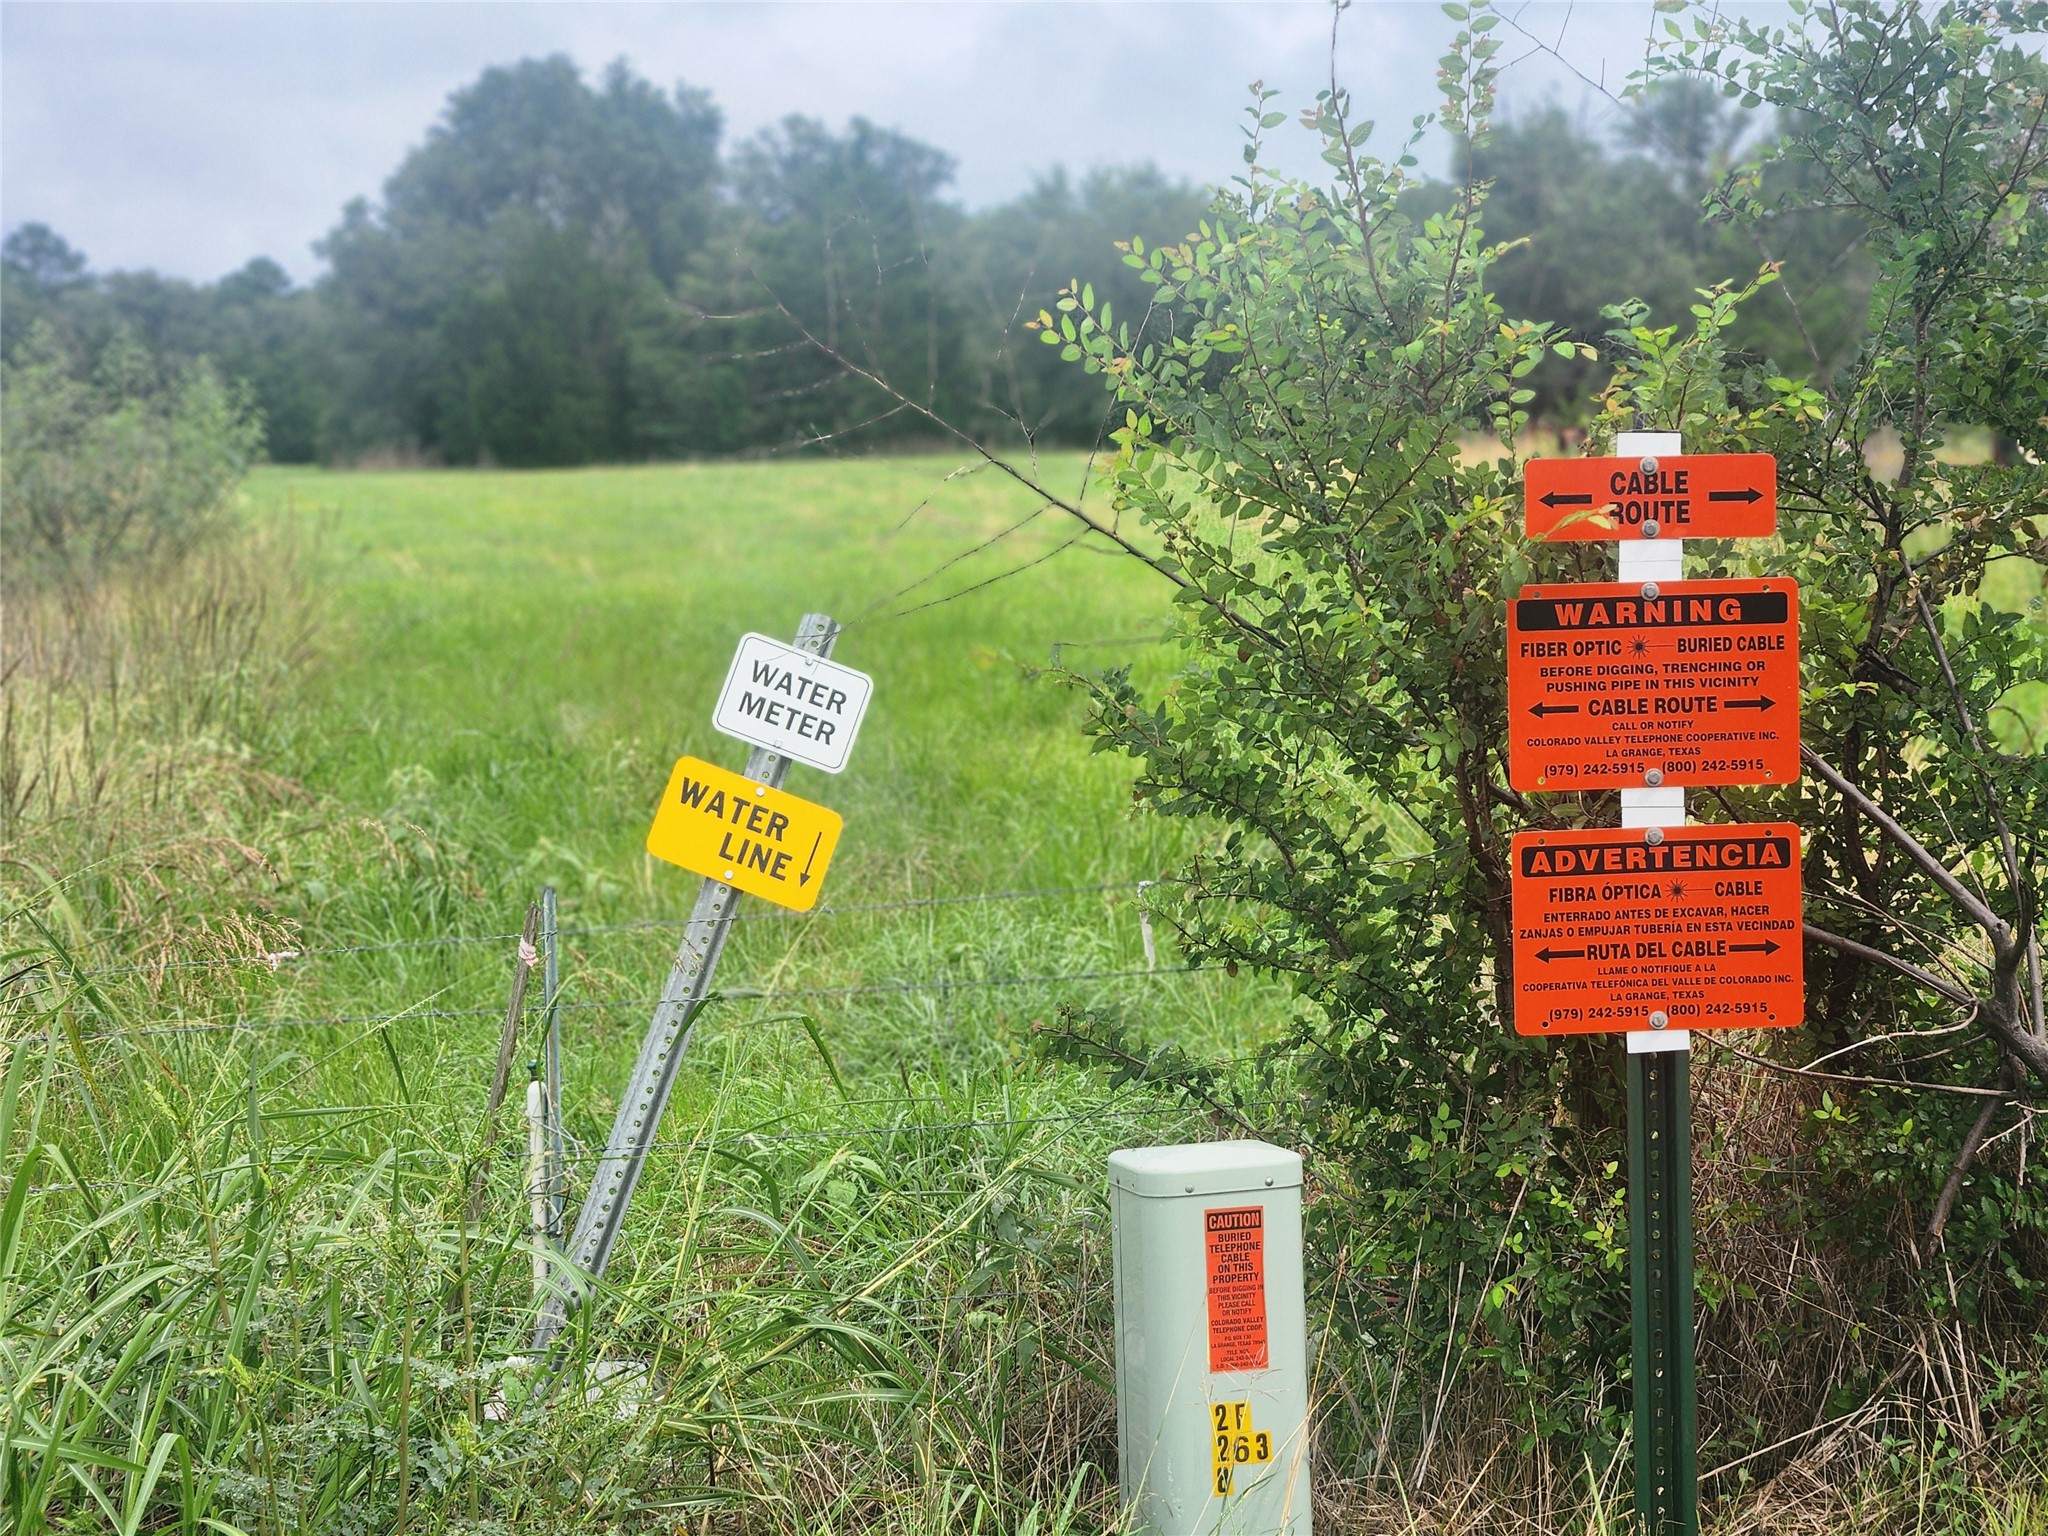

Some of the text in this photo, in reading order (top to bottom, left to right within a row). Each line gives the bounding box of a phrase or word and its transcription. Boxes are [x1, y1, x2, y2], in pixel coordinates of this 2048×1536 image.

[1610, 471, 1689, 495] CABLE
[1610, 501, 1691, 524] ROUTE
[1554, 598, 1741, 626] WARNING
[1520, 635, 1785, 658] FIBER OPTIC BURIED CABLE
[1540, 661, 1765, 677] BEFORE DIGGING, TRENCHING OR
[752, 659, 847, 715] WATER
[1546, 676, 1759, 692] PUSHING PIPE IN THIS VICINITY
[1588, 696, 1717, 716] CABLE ROUTE
[738, 691, 836, 746] METER
[1612, 720, 1694, 731] CALL OR NOTIFY
[1527, 731, 1779, 747] COLORADO VALLEY TELEPHONE COOPERATIVE INC.
[1606, 747, 1701, 758] LA GRANGE, TEXAS
[1544, 759, 1764, 778] (979) 242-5915 (800) 242-5915
[680, 777, 789, 842] WATER
[718, 832, 793, 882] LINE
[1530, 843, 1782, 873] ADVERTENCIA
[1550, 880, 1762, 903] FIBRA ÓPTICA CABLE
[1544, 905, 1769, 923] ENTERRADO ANTES DE EXCAVAR, HACER
[1520, 919, 1795, 939] ZANJAS O EMPUJAR TUBERÍA EN ESTA VECINDAD
[1587, 940, 1726, 960] RUTA DEL CABLE
[1598, 963, 1716, 976] LLAME O NOTIFIQUE A LA
[1522, 974, 1794, 992] COOPERATIVA TELEFÓNICA DEL VALLE DE COLORADO INC.
[1610, 990, 1704, 1001] LA GRANGE, TEXAS
[1549, 1002, 1767, 1022] (979) 242-5915 (800) 242-5915
[1209, 1213, 1259, 1229] CAUTION
[1218, 1232, 1251, 1242] BURIED
[1209, 1241, 1261, 1253] TELEPHONE
[1221, 1252, 1250, 1263] CABLE
[1218, 1262, 1253, 1273] ON THIS
[1213, 1272, 1259, 1284] PROPERTY
